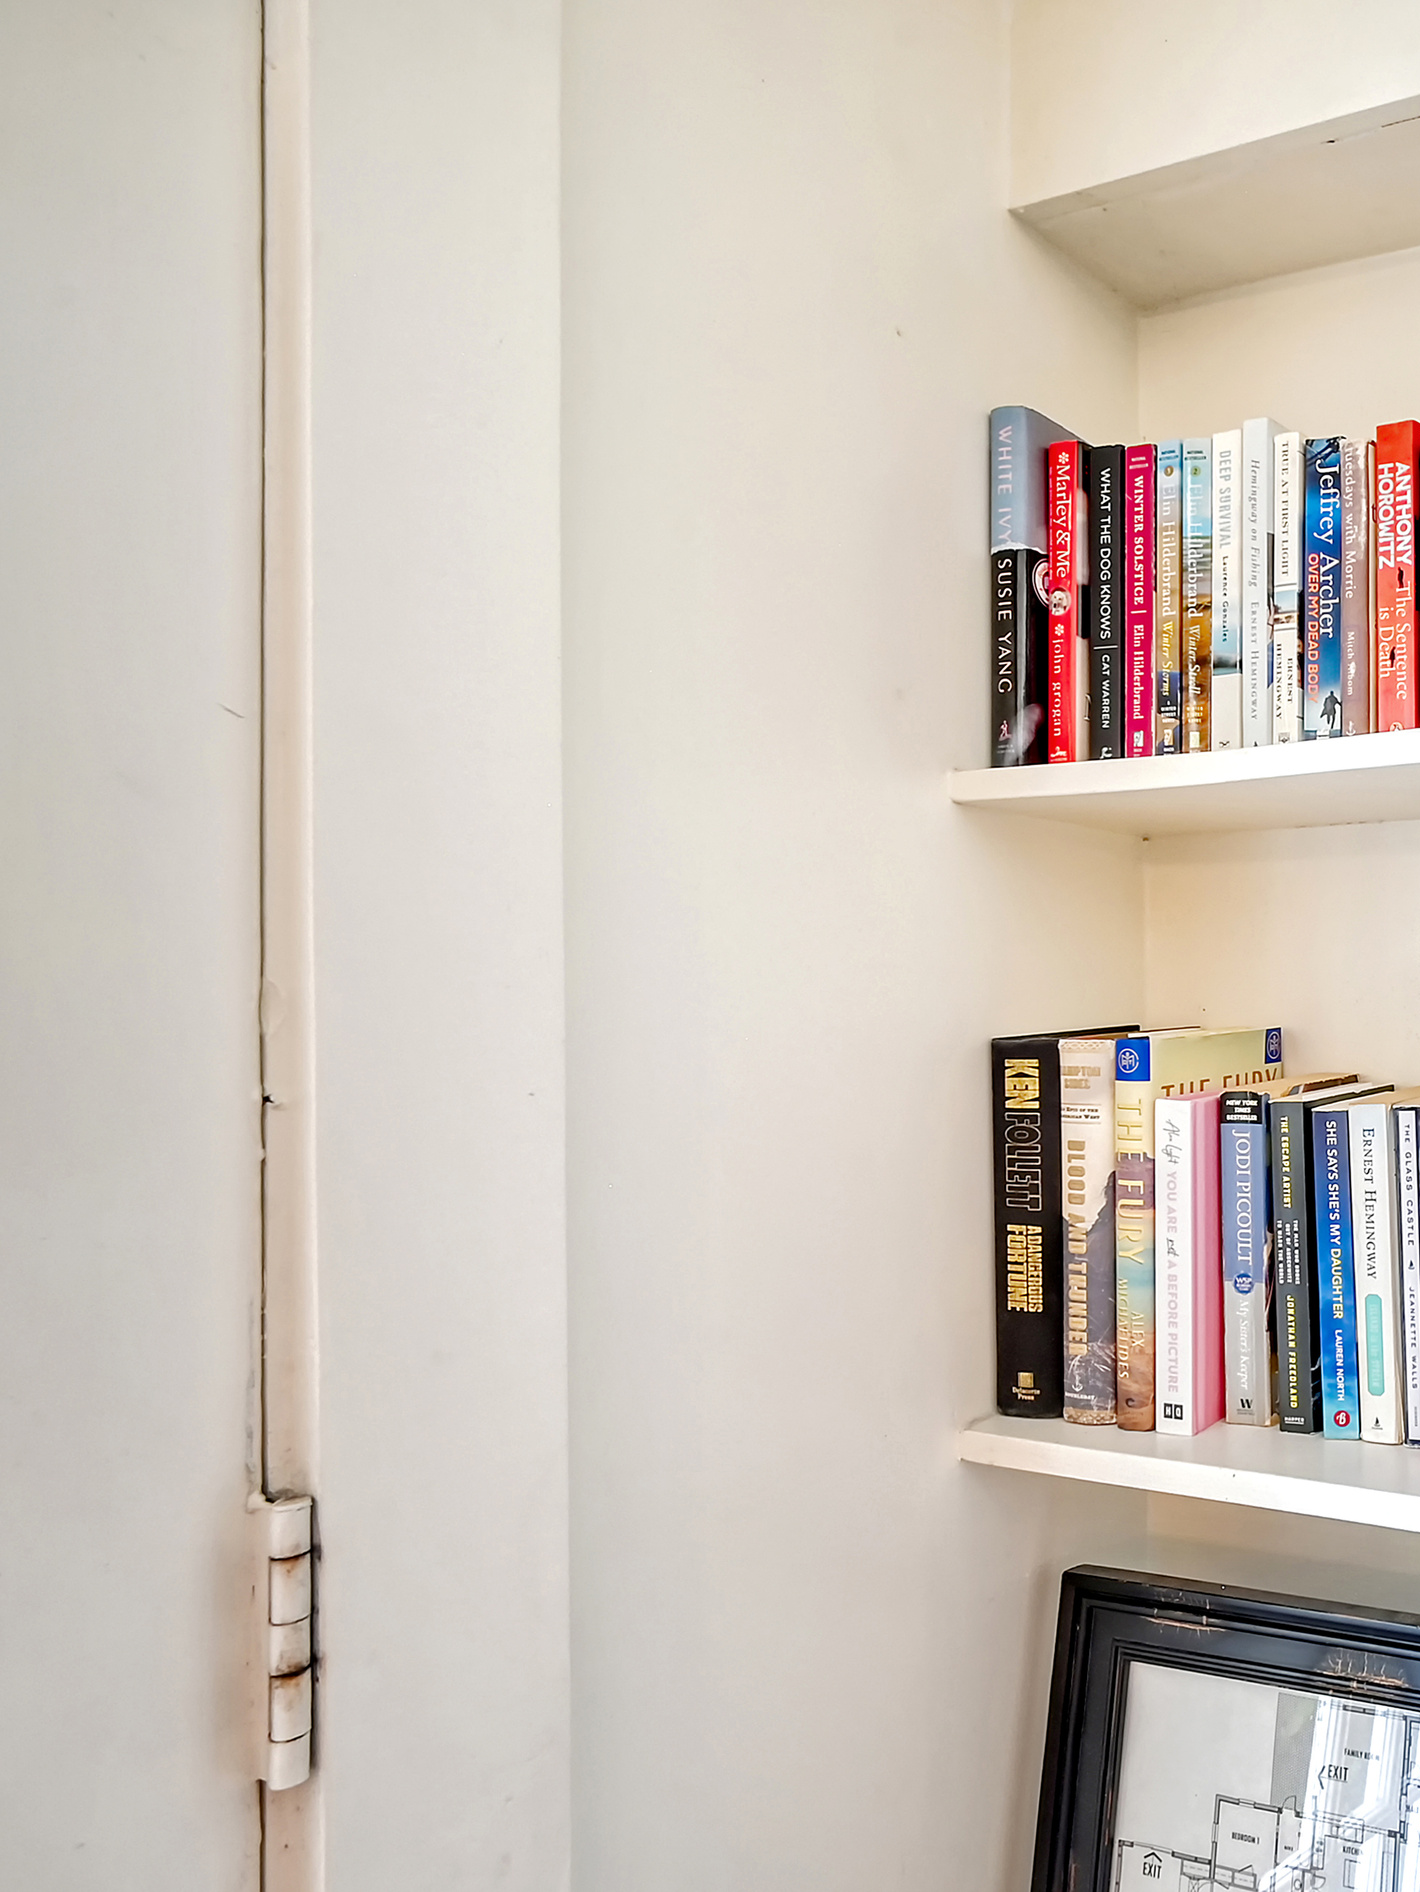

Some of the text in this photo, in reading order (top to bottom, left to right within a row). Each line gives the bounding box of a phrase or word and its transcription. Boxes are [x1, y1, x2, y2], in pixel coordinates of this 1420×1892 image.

[998, 426, 1012, 544] WHITE IVY
[1053, 465, 1072, 578] Marley & Me
[1134, 475, 1144, 533] WINTER
[1219, 451, 1231, 549] DEEP SURVIVAL
[1281, 441, 1289, 576] TRUE AT FIRST LIGHT
[1378, 463, 1395, 569] HOROWITZ
[1395, 462, 1412, 565] ANTHONY
[1100, 468, 1111, 639] WHAT THE DOG KNOWS
[1162, 484, 1176, 617] Elin Hilderbrand
[1248, 460, 1260, 587] Hemingway on Fishing
[1313, 459, 1340, 639] Jeffrey Archer
[1345, 514, 1356, 544] with
[1134, 537, 1144, 605] SOLSTICE
[1345, 551, 1356, 599] Morrie
[997, 559, 1013, 693] SUSIE YANG
[1162, 621, 1173, 658] Winter
[1308, 553, 1319, 703] OVER MY DEAD BODY
[1379, 607, 1395, 678] is Death
[1395, 581, 1412, 699] The Sentence
[1052, 639, 1065, 736] john grogan
[1101, 654, 1110, 729] CAT WARREN
[1133, 624, 1145, 719] Elin Hilderbrand
[1162, 661, 1173, 696] Storms
[1004, 1058, 1042, 1211] KEN FOLLETT
[1232, 1129, 1251, 1175] JODI
[1280, 1116, 1292, 1209] THE ESCAPE ARTIST
[1405, 1151, 1413, 1191] GLASS
[1067, 1140, 1086, 1205] BLOOD
[1117, 1099, 1145, 1265] THE FURY
[1167, 1171, 1177, 1202] YOU
[1362, 1128, 1378, 1279] ERNEST HEMINGWAY
[1068, 1213, 1088, 1255] AND
[1167, 1205, 1177, 1234] ARE
[1236, 1181, 1252, 1266] PICOULT
[1326, 1121, 1344, 1319] SHE SAYS SHE'S MY DAUGHTER
[1406, 1200, 1415, 1246] CASTLE
[1007, 1224, 1028, 1312] FORTUNE
[1027, 1234, 1043, 1313] DANGEROUS
[1167, 1261, 1177, 1270] A
[1167, 1273, 1178, 1328] BEFORE
[1068, 1262, 1088, 1356] THUNDER
[1118, 1279, 1130, 1379] MICHAELIDES
[1131, 1311, 1145, 1347] ALEX
[1236, 1300, 1249, 1318] My
[1409, 1287, 1417, 1348] JEANNETTE
[1167, 1333, 1179, 1393] PICTURE
[1237, 1355, 1250, 1390] Keeper
[1286, 1295, 1299, 1409] JONATHAN FREEDLAND
[1335, 1329, 1345, 1401] LAUREN NORTH
[1328, 1764, 1349, 1782] EXIT
[1344, 1748, 1363, 1759] FAMILY
[1142, 1861, 1162, 1880] EXIT
[1231, 1832, 1256, 1844] BEDROOM
